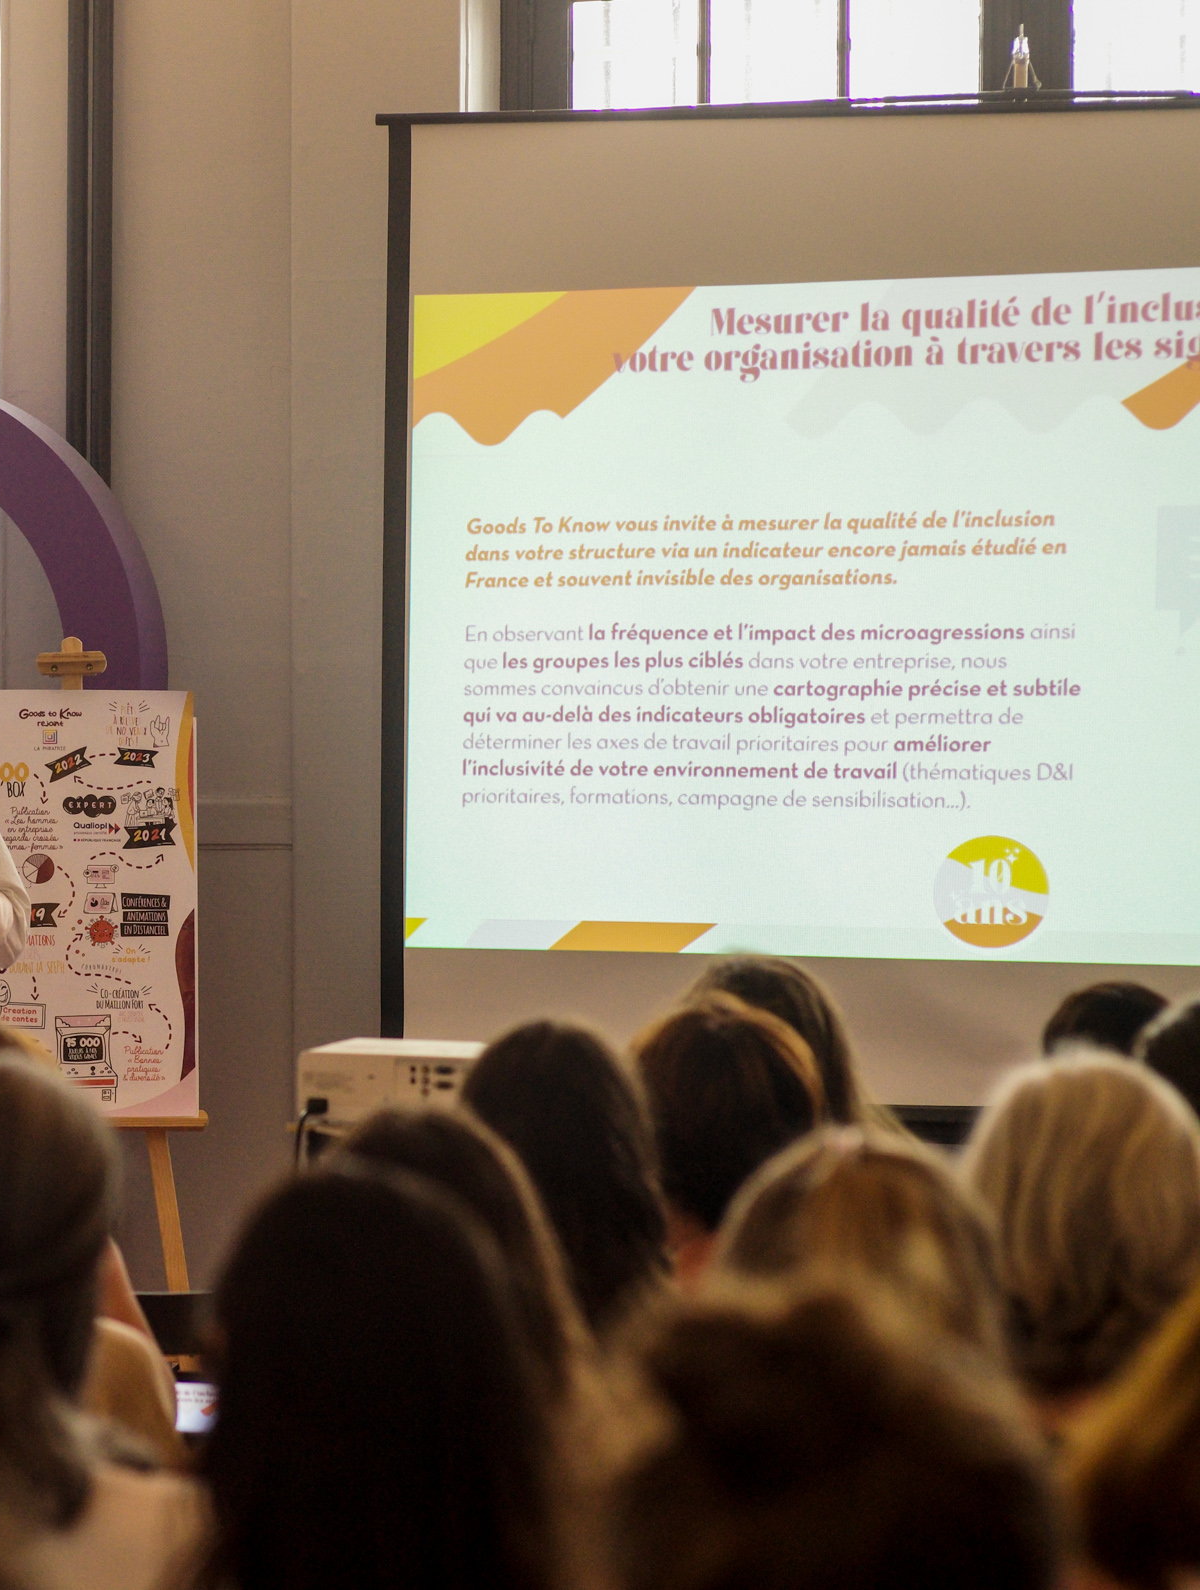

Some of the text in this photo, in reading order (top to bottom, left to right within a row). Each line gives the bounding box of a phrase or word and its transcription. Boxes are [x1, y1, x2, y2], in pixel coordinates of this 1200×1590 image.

[712, 297, 1071, 340] Mesurer la qualité de
[612, 334, 1142, 381] votre organisation à travers les
[467, 509, 1054, 535] Goods To Know vous invite à mesurer la qualité de l'inclusion
[465, 538, 1066, 562] dans votre structure via un indicateur encore jamais étudié en
[465, 568, 896, 591] France et souvent invisible des organisations.
[466, 623, 1076, 646] En observant la fréquence et l'impact des microagressions ainsi
[464, 651, 1007, 674] que les groupes les plus ciblés dans votre entreprise, nous
[465, 679, 1081, 702] sommes convaincus d'obtenir une cartographie précise et subtile
[463, 706, 1023, 729] qui va au-delà des indicateurs obligatoires et permettra de
[463, 732, 991, 757] déterminer les axes de travail prioritaires pour améliorer
[54, 754, 83, 774] 2022
[123, 752, 150, 763] 2023
[463, 760, 564, 777] l'inclusivité
[570, 760, 593, 777] de
[599, 762, 648, 777] votre
[654, 762, 798, 779] environnement
[804, 762, 828, 780] de
[834, 763, 896, 780] travail
[903, 764, 1030, 785] (thématiques
[7, 782, 26, 798] BOX
[462, 789, 564, 808] prioritaires,
[571, 786, 672, 807] formations,
[678, 795, 777, 811] campagne
[783, 790, 806, 808] de
[73, 822, 108, 830] Qualiopi
[134, 828, 166, 842] 2021
[969, 858, 1012, 894] 10
[954, 899, 1028, 925] ans
[65, 1037, 101, 1048] 15 000
